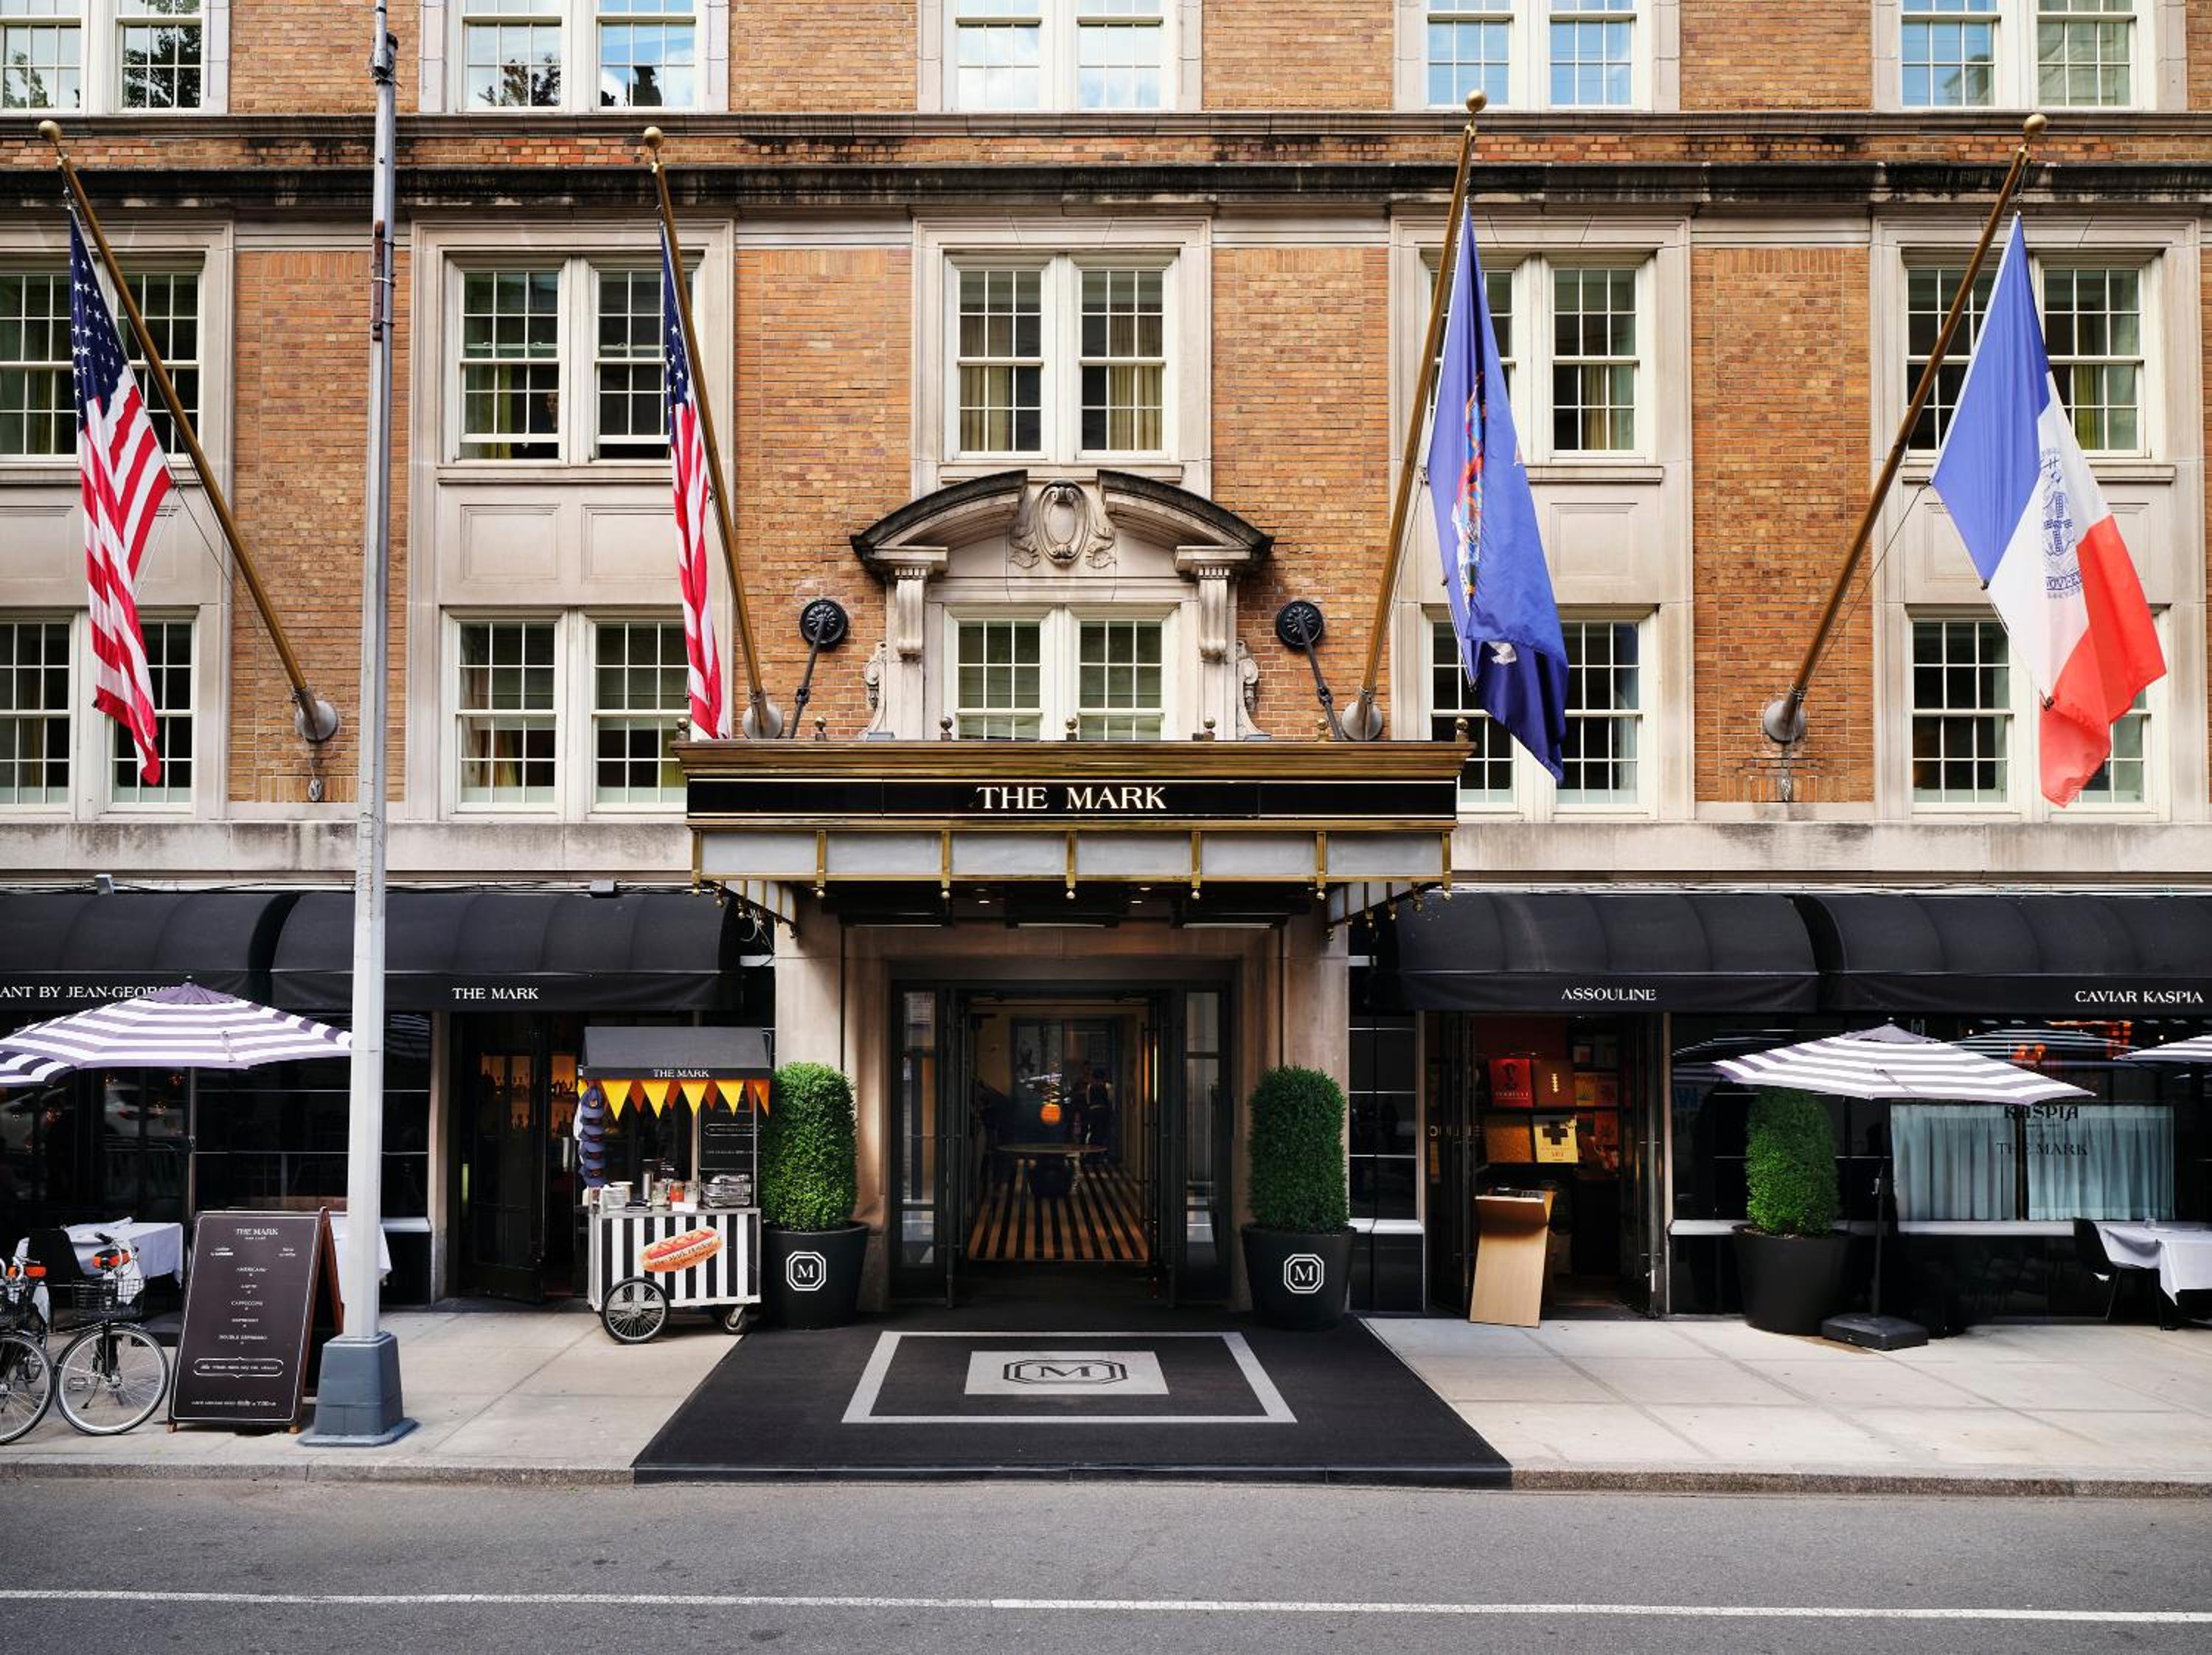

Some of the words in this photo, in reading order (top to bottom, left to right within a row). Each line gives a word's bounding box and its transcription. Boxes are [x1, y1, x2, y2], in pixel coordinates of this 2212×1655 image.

[976, 786, 1048, 809] THE
[1066, 785, 1166, 810] MARK
[38, 986, 60, 998] BY
[451, 988, 486, 999] THE
[491, 988, 539, 999] MARK
[1561, 988, 1657, 1001] ASSOULINE
[2075, 990, 2138, 1003] CAVIAR
[2143, 990, 2204, 1004] KASPIA
[654, 1069, 675, 1078] THE
[677, 1069, 709, 1078] MARK
[2037, 1143, 2088, 1156] MARK
[253, 1227, 278, 1235] MARK
[797, 1263, 815, 1278] M
[1294, 1265, 1314, 1282] M
[1039, 1366, 1091, 1378] M
